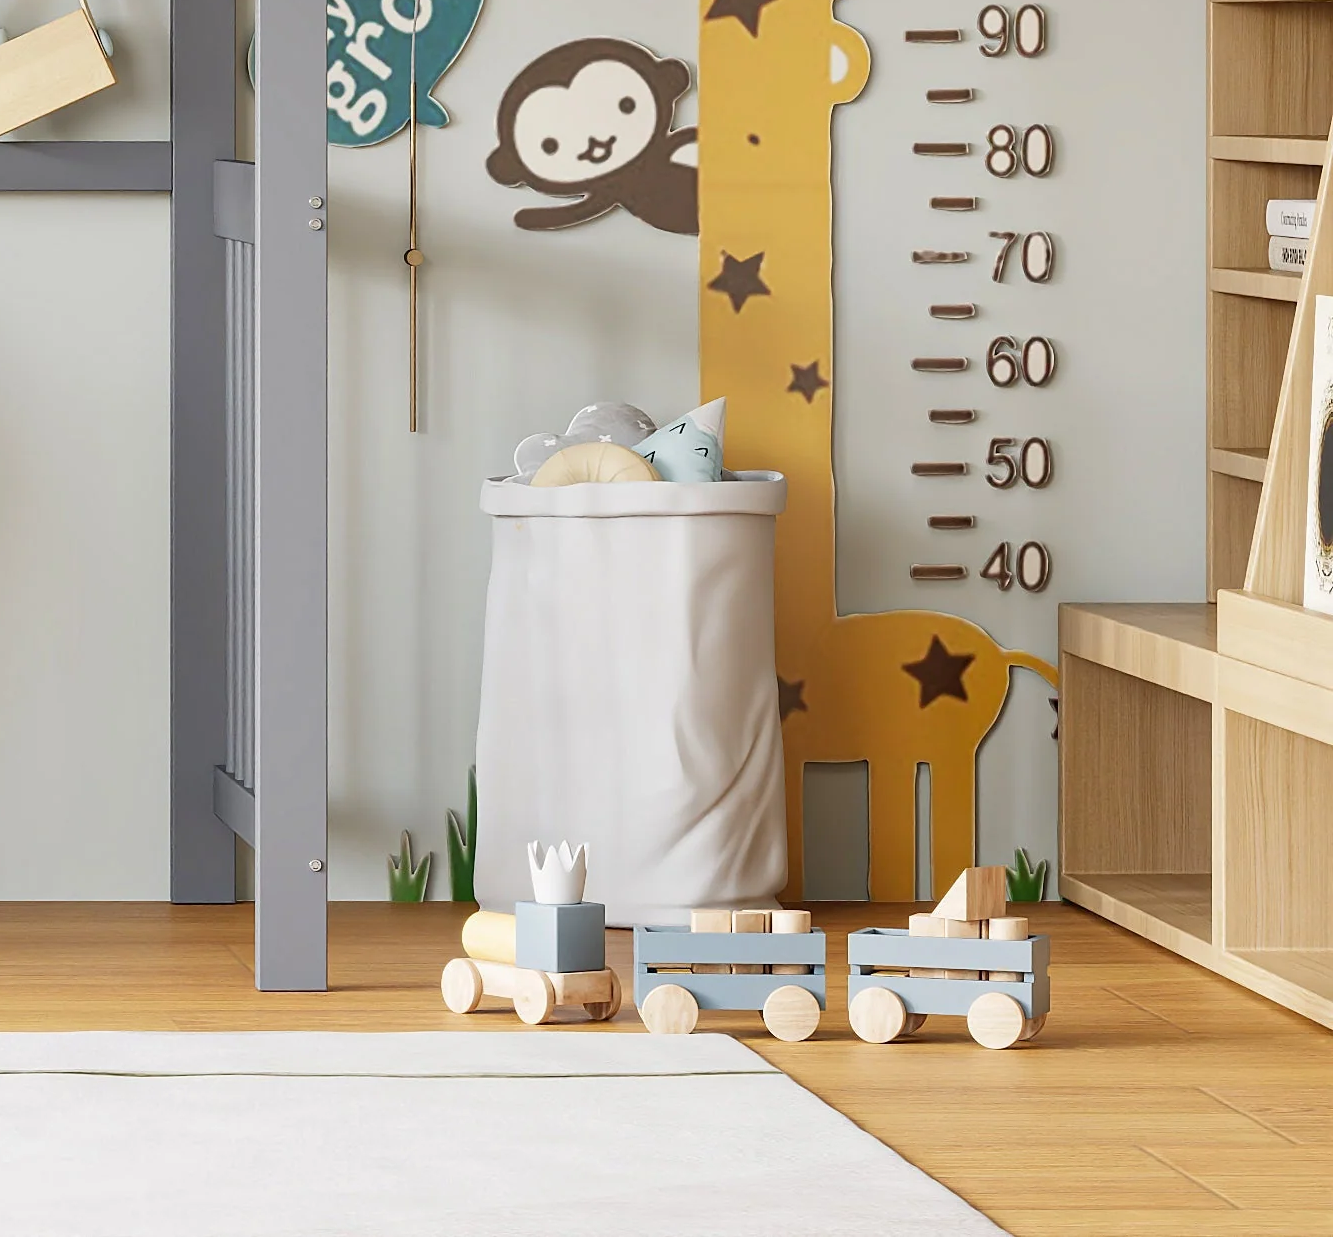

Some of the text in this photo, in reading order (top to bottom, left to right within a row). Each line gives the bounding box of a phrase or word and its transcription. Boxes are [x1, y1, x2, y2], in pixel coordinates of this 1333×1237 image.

[976, 3, 1047, 59] 90
[984, 123, 1053, 179] 80
[988, 230, 1053, 284] 70
[985, 335, 1056, 388] 60
[985, 436, 1053, 490] 50
[979, 540, 1052, 593] 40
